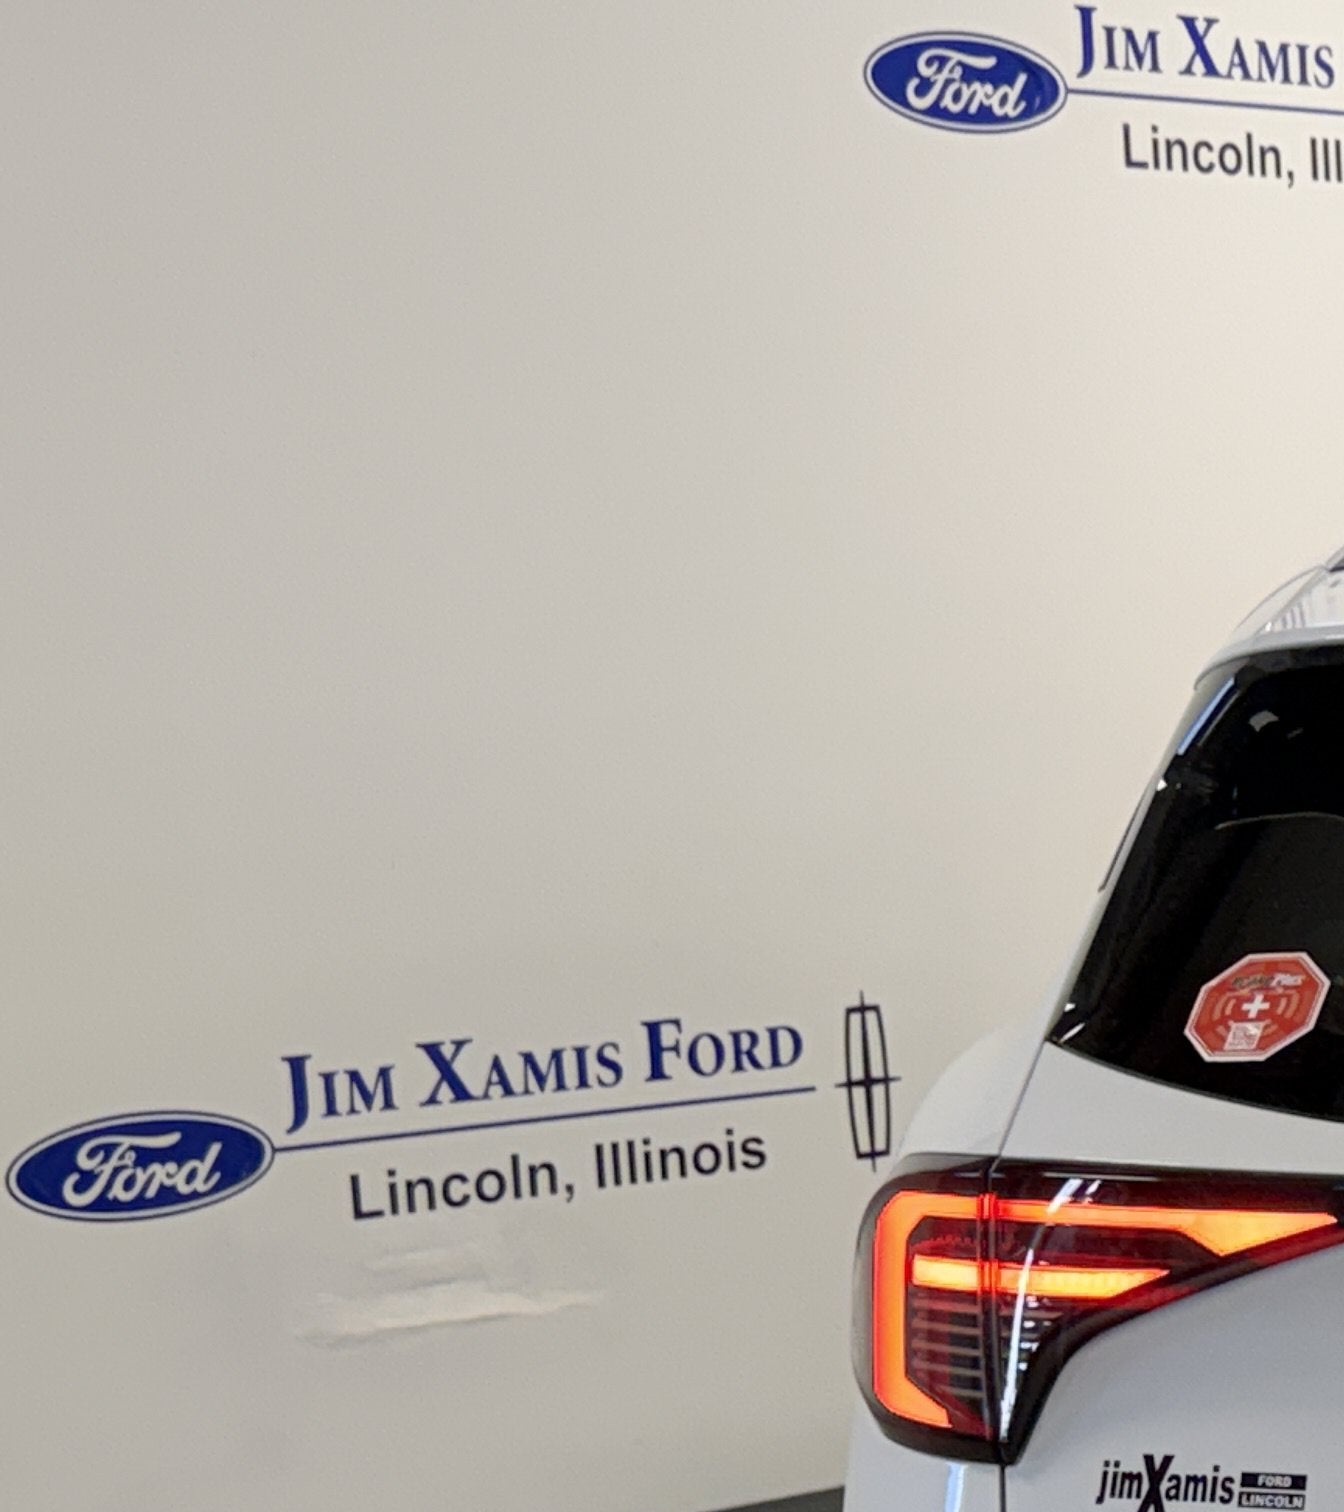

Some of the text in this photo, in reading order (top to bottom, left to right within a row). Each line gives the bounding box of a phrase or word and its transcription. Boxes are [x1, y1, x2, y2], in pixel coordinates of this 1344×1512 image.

[906, 47, 1030, 118] Ford
[1074, 4, 1161, 79] JIM
[1177, 14, 1336, 90] XAMIS
[1122, 123, 1294, 188] Lincoln,
[281, 1018, 803, 1134] JIM XAMIS FORD
[63, 1131, 222, 1208] Ford
[349, 1128, 767, 1221] Lincoln, Illinois
[1241, 1493, 1304, 1508] LINCOLN
[1257, 1474, 1293, 1488] FORD
